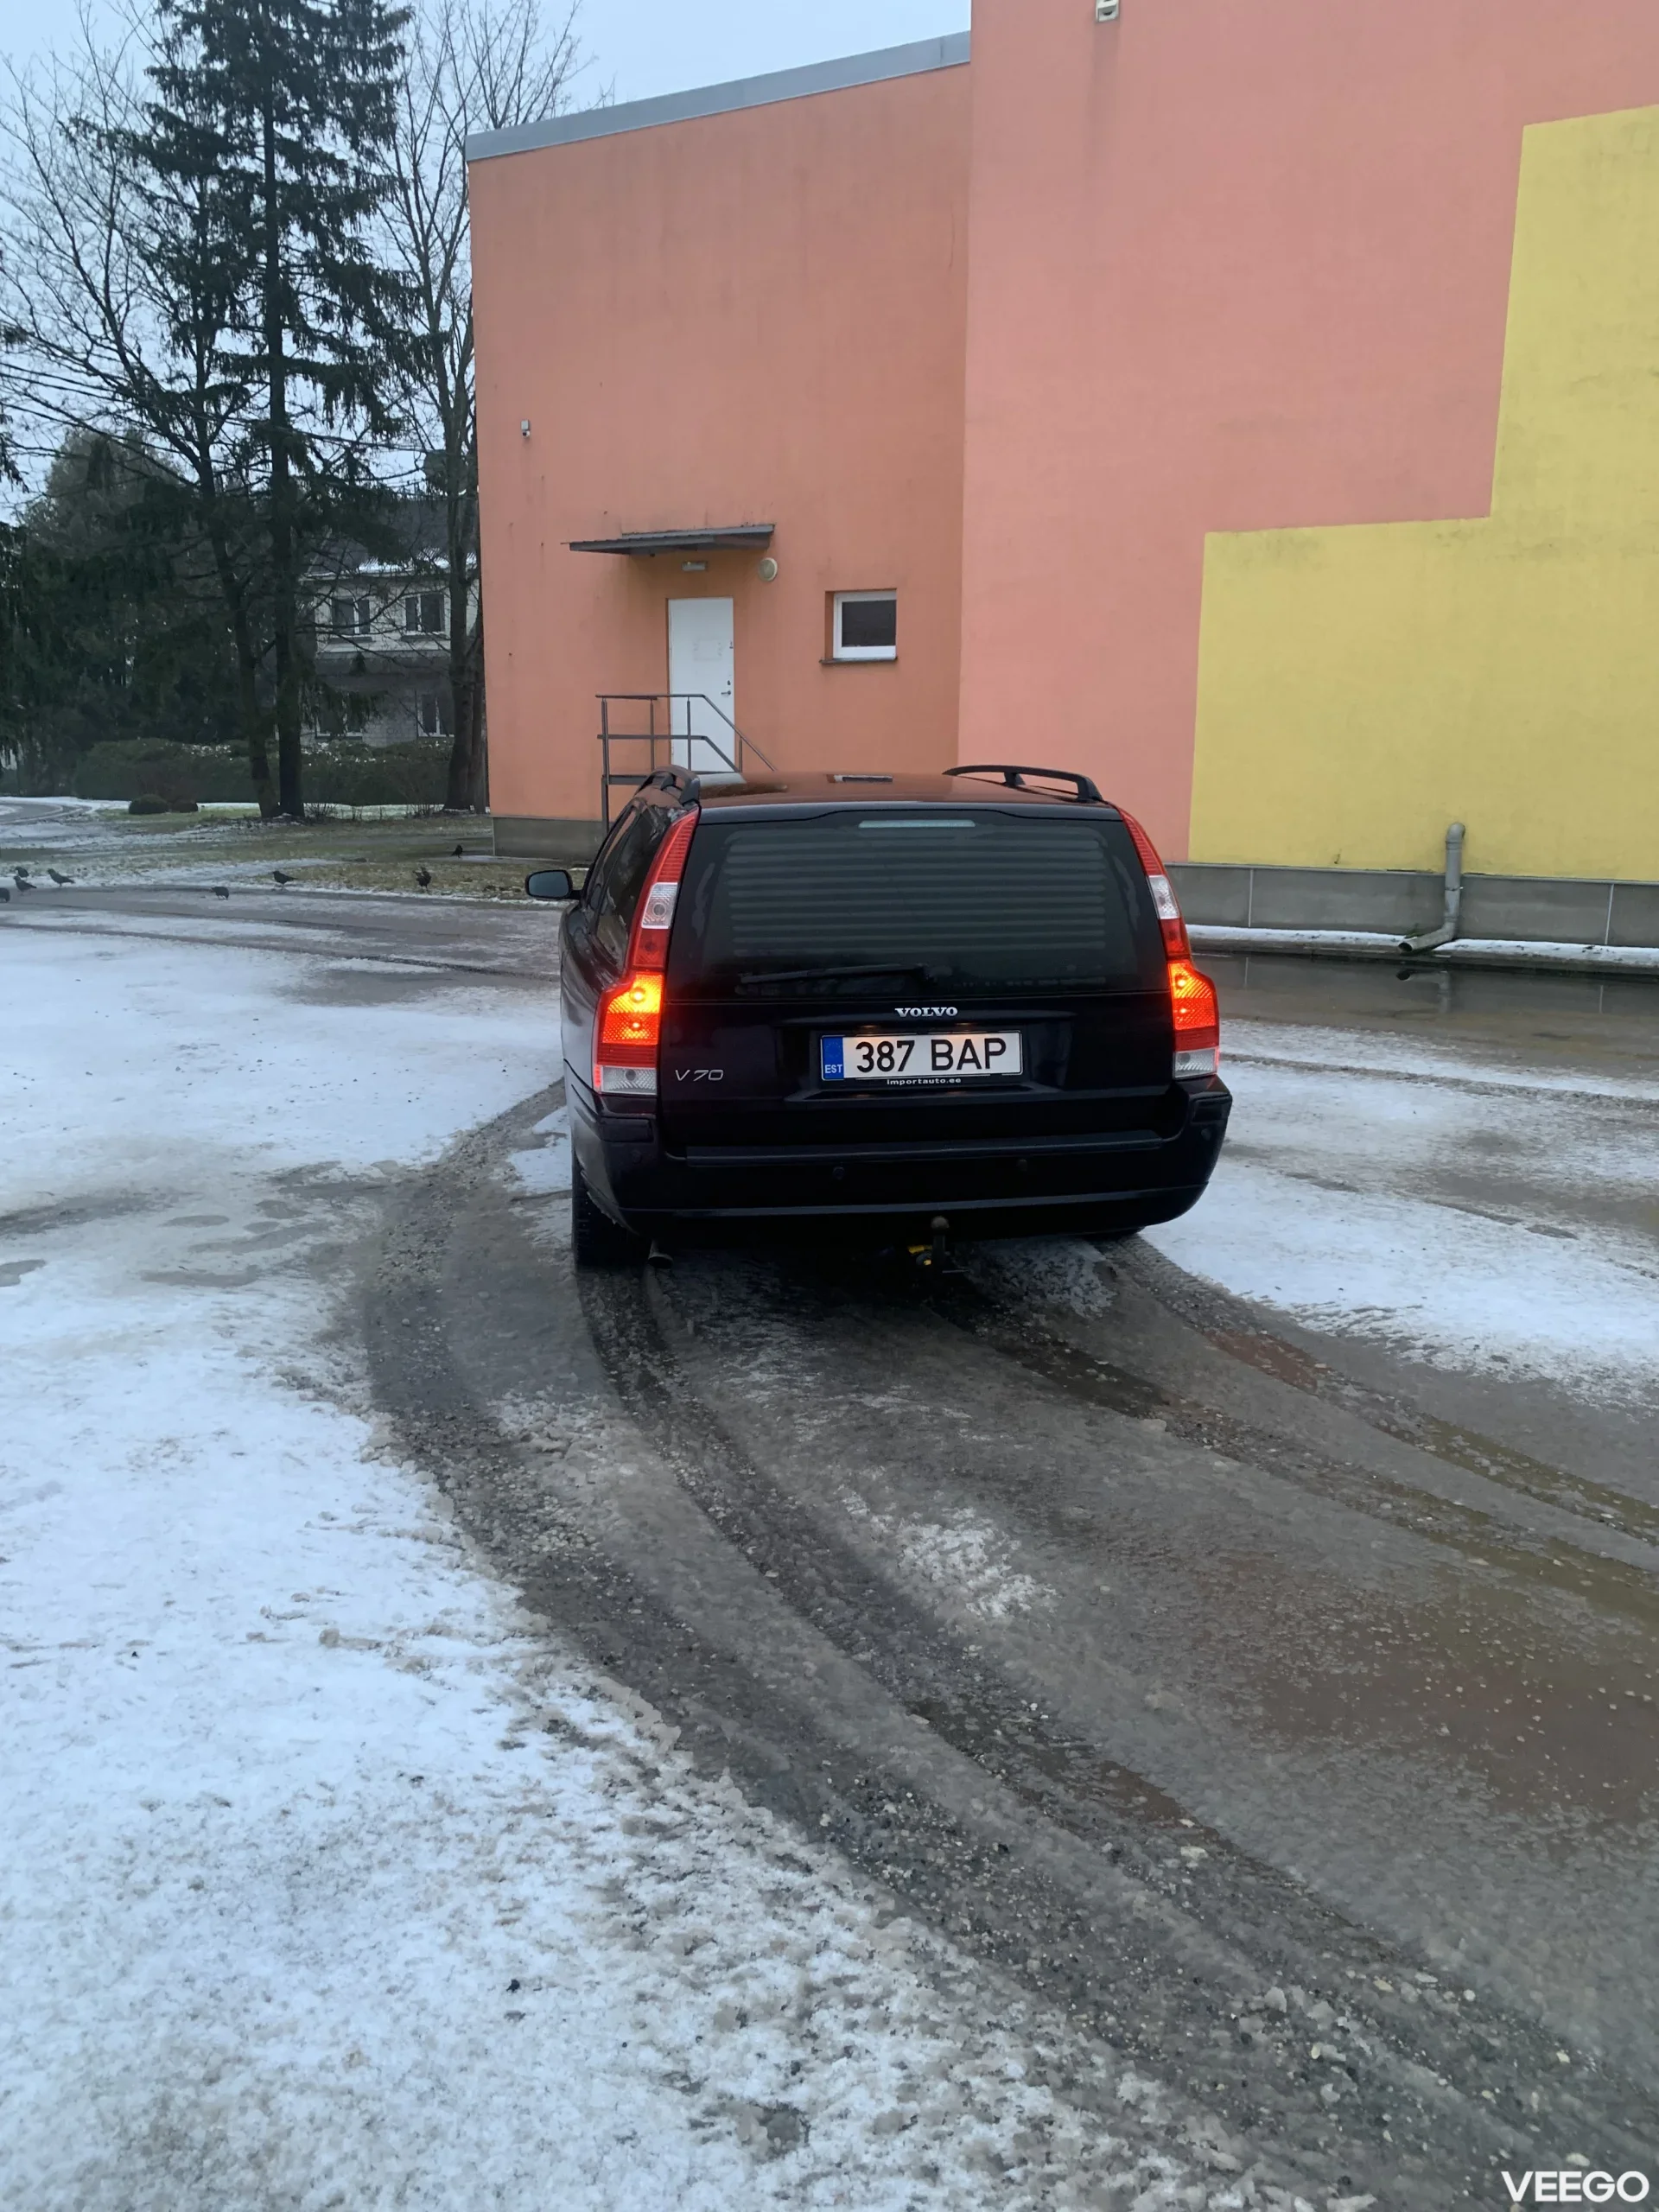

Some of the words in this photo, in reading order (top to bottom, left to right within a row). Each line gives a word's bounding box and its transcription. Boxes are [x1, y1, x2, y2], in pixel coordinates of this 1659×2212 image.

[894, 1007, 958, 1017] VOLVO
[824, 1064, 842, 1073] EST
[855, 1040, 915, 1073] 387
[931, 1038, 1007, 1071] BAP
